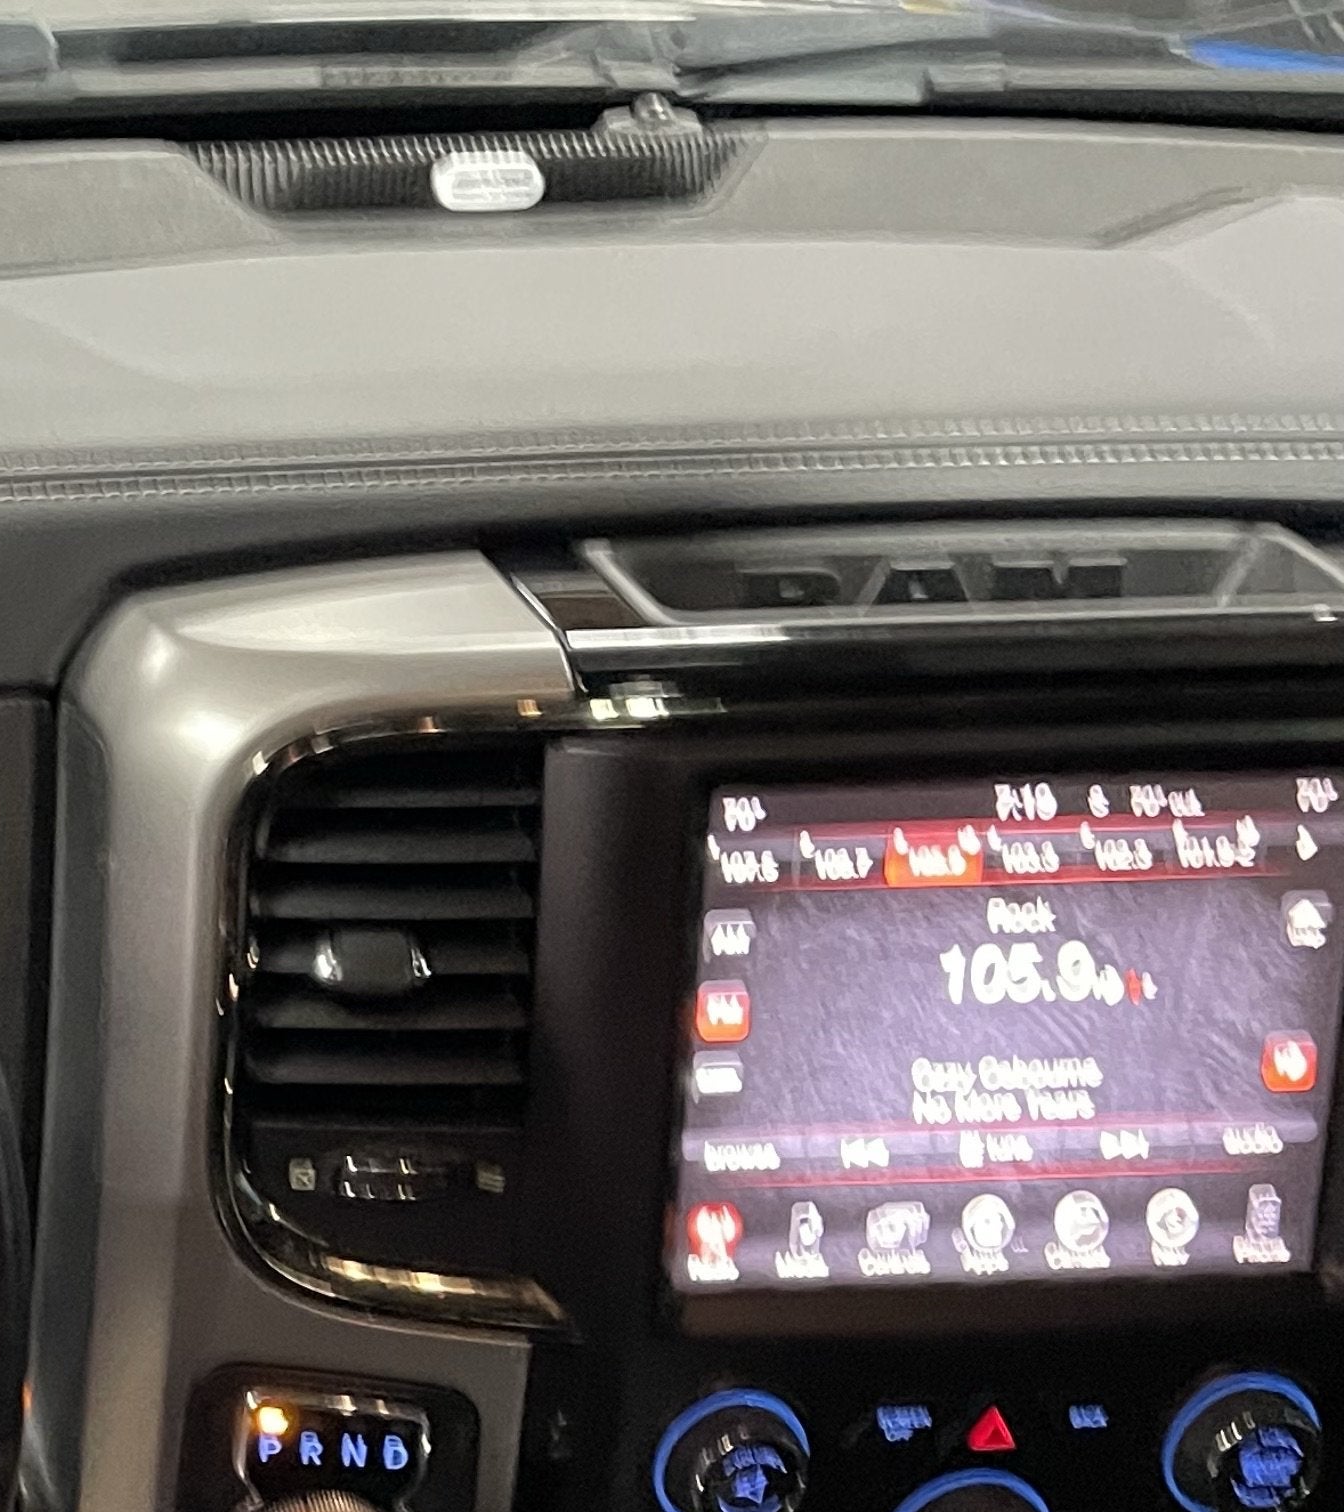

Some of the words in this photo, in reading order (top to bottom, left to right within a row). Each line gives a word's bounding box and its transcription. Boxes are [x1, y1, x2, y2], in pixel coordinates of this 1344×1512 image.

[986, 895, 1057, 935] Rock
[939, 939, 1096, 1006] 105.9
[911, 1056, 977, 1094] Ozzy
[977, 1054, 1104, 1091] Osbourne
[912, 1090, 953, 1125] No
[954, 1088, 1023, 1123] More
[1025, 1086, 1097, 1122] Tears
[257, 1433, 283, 1464] P
[298, 1430, 324, 1467] R
[340, 1432, 368, 1468] N
[382, 1434, 409, 1471] D
